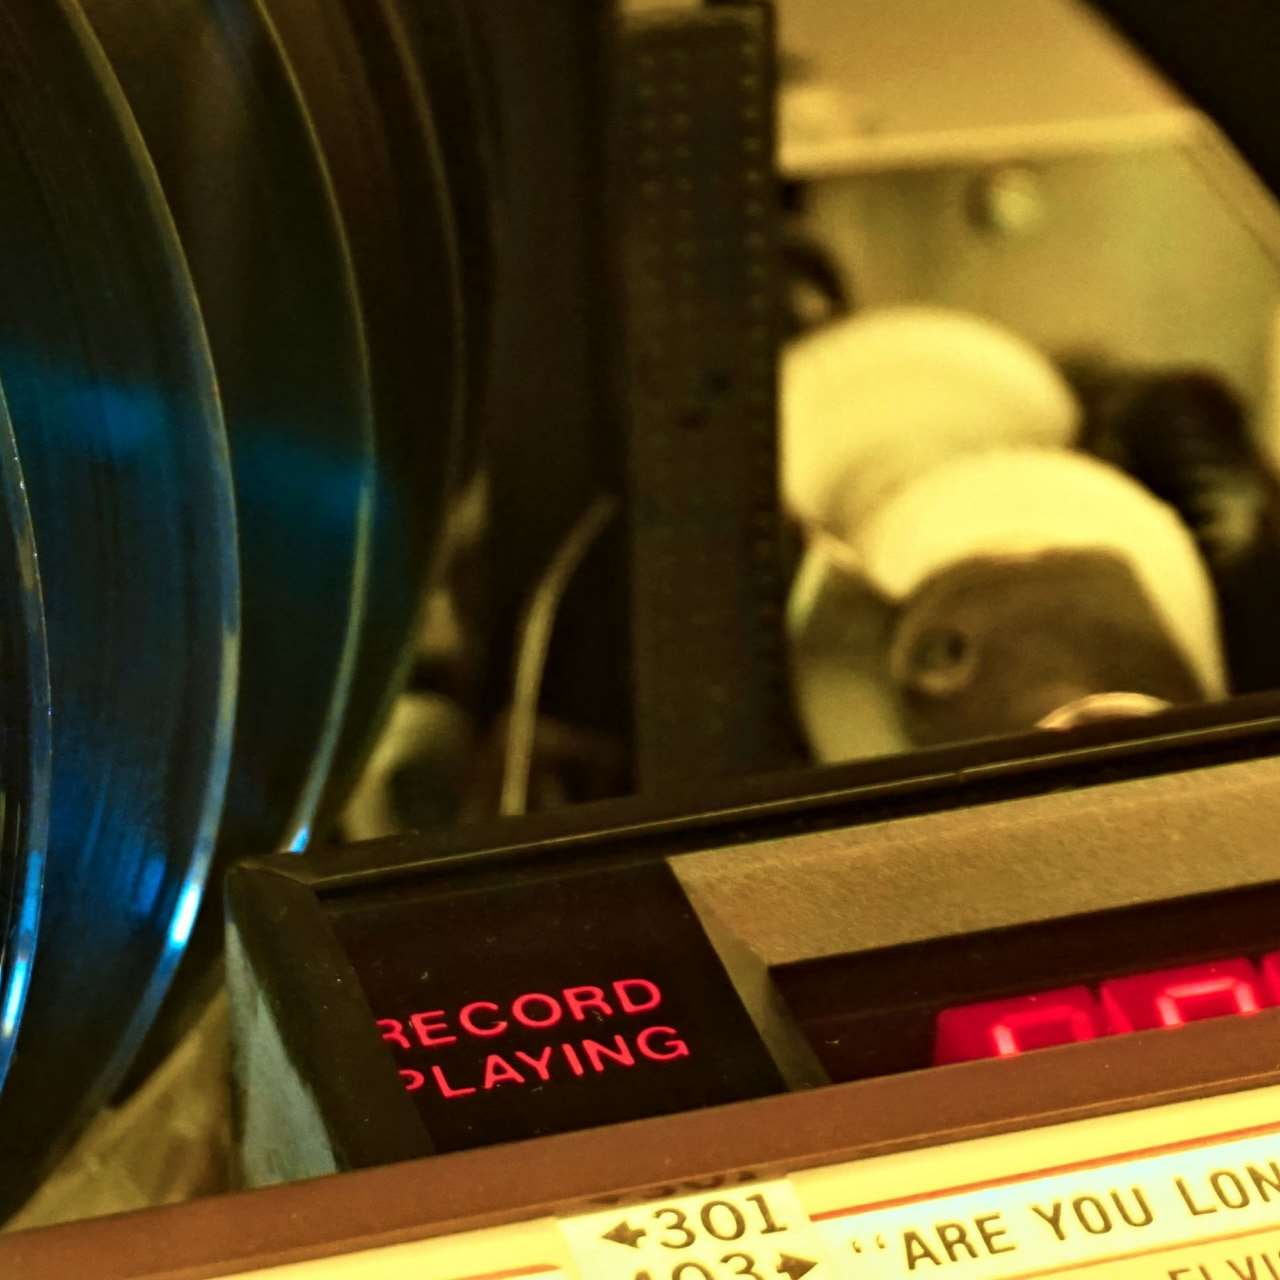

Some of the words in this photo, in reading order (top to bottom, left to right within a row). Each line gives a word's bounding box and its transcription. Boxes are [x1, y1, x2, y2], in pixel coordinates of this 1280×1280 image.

[375, 977, 663, 1050] RECORD
[652, 1192, 789, 1250] 301
[1030, 1186, 1155, 1242] YOU
